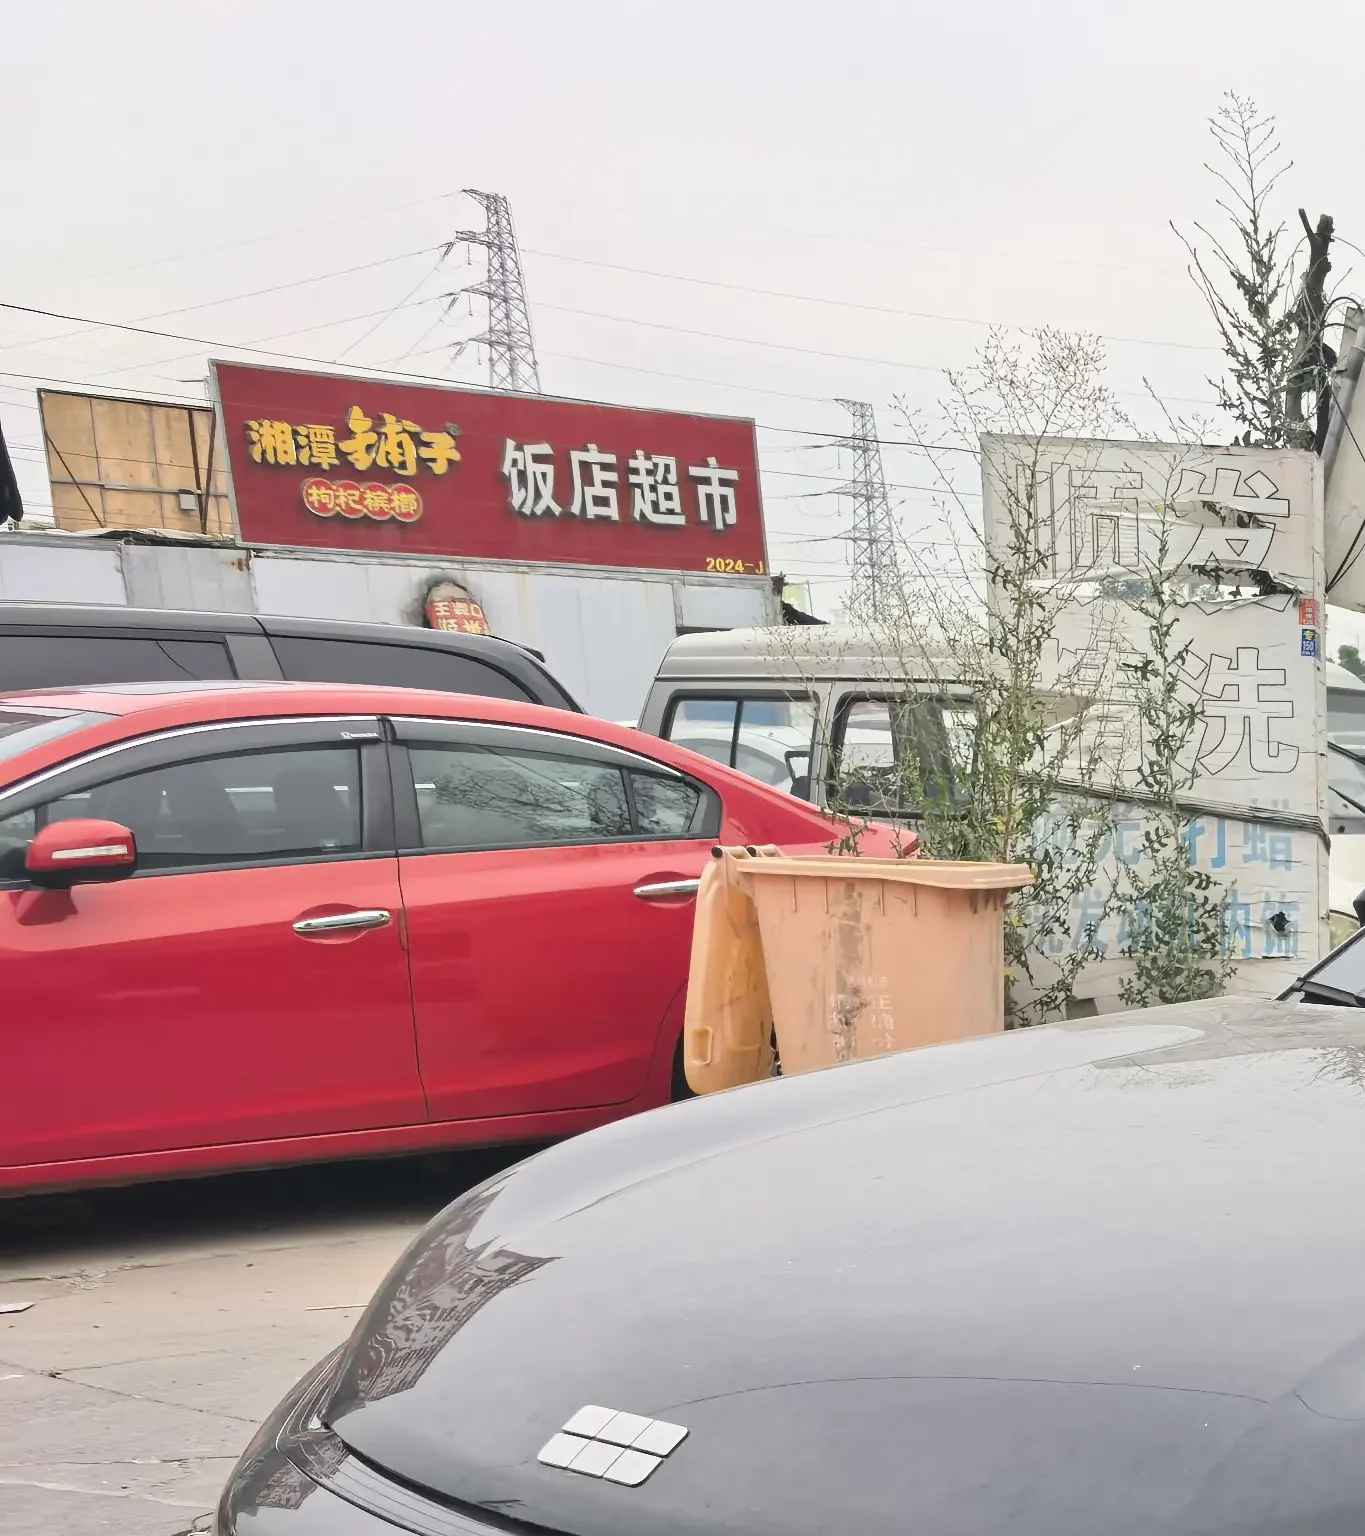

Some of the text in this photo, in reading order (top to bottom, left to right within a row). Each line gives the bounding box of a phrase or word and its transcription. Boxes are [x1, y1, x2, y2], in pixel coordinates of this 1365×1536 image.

[247, 405, 462, 475] 湘潭铺子
[501, 438, 740, 530] 饭店超市
